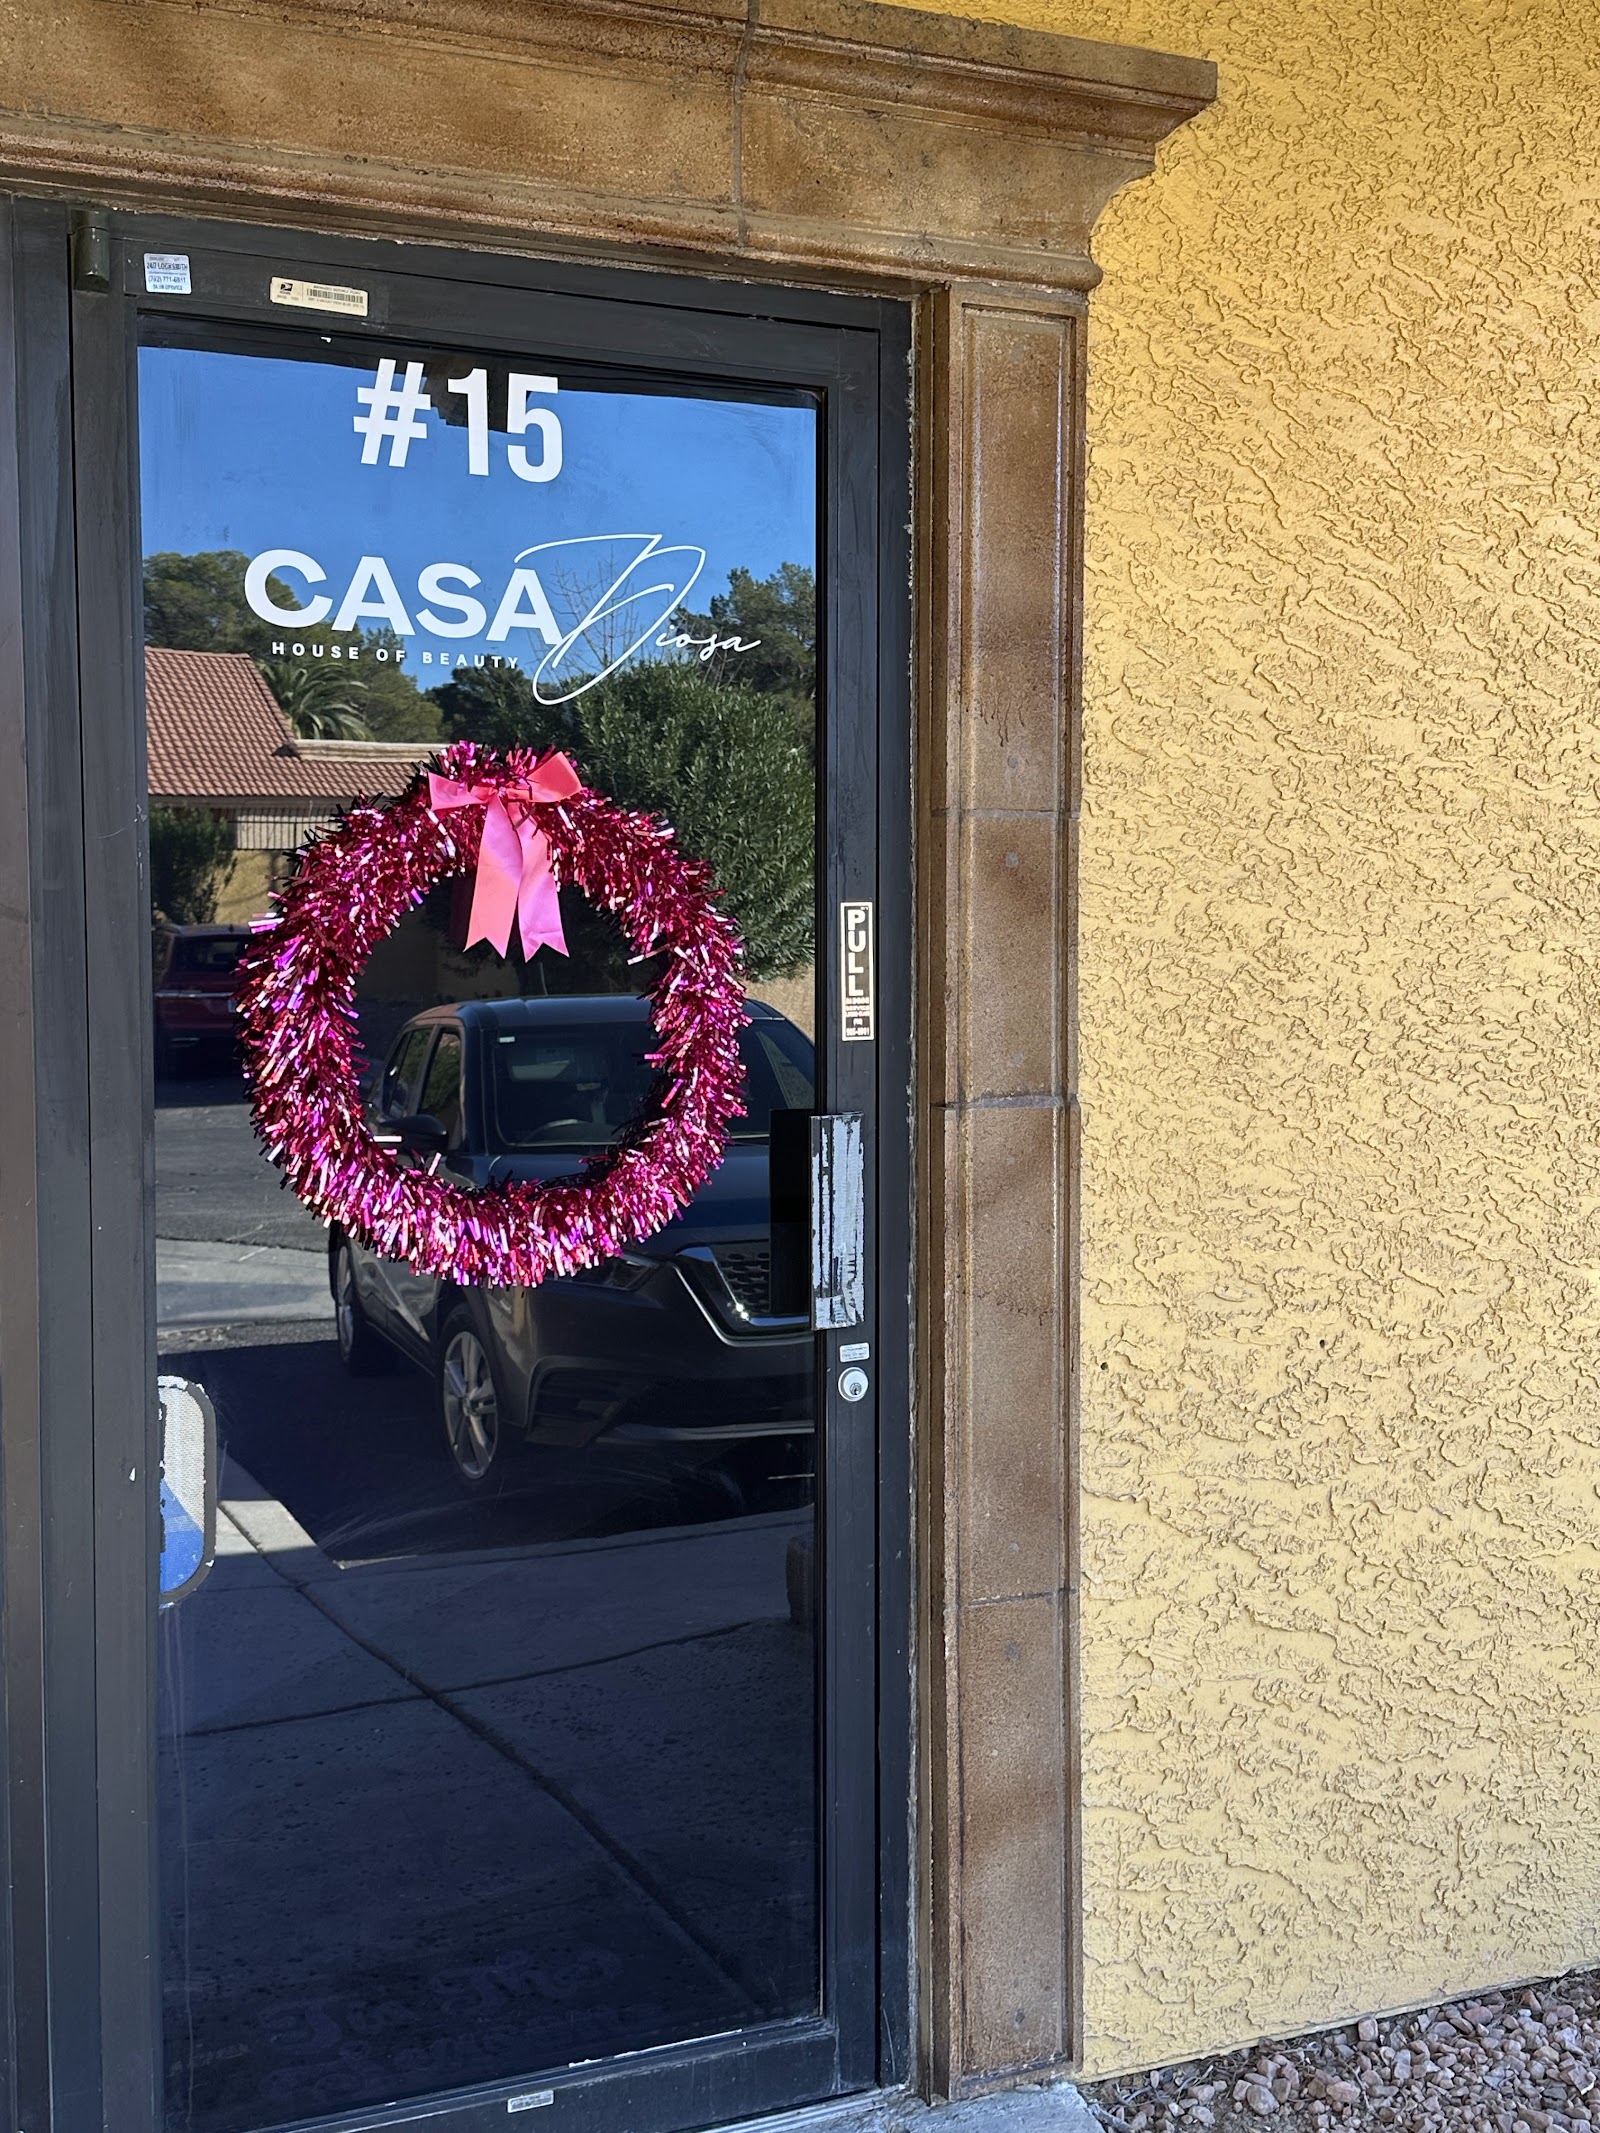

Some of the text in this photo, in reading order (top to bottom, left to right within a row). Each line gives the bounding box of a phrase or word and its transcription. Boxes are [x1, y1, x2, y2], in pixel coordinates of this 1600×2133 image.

[352, 357, 564, 484] #15
[243, 548, 563, 646] CASA
[271, 641, 520, 670] HOUSE OF BEAUTY
[847, 908, 867, 997] PULL
